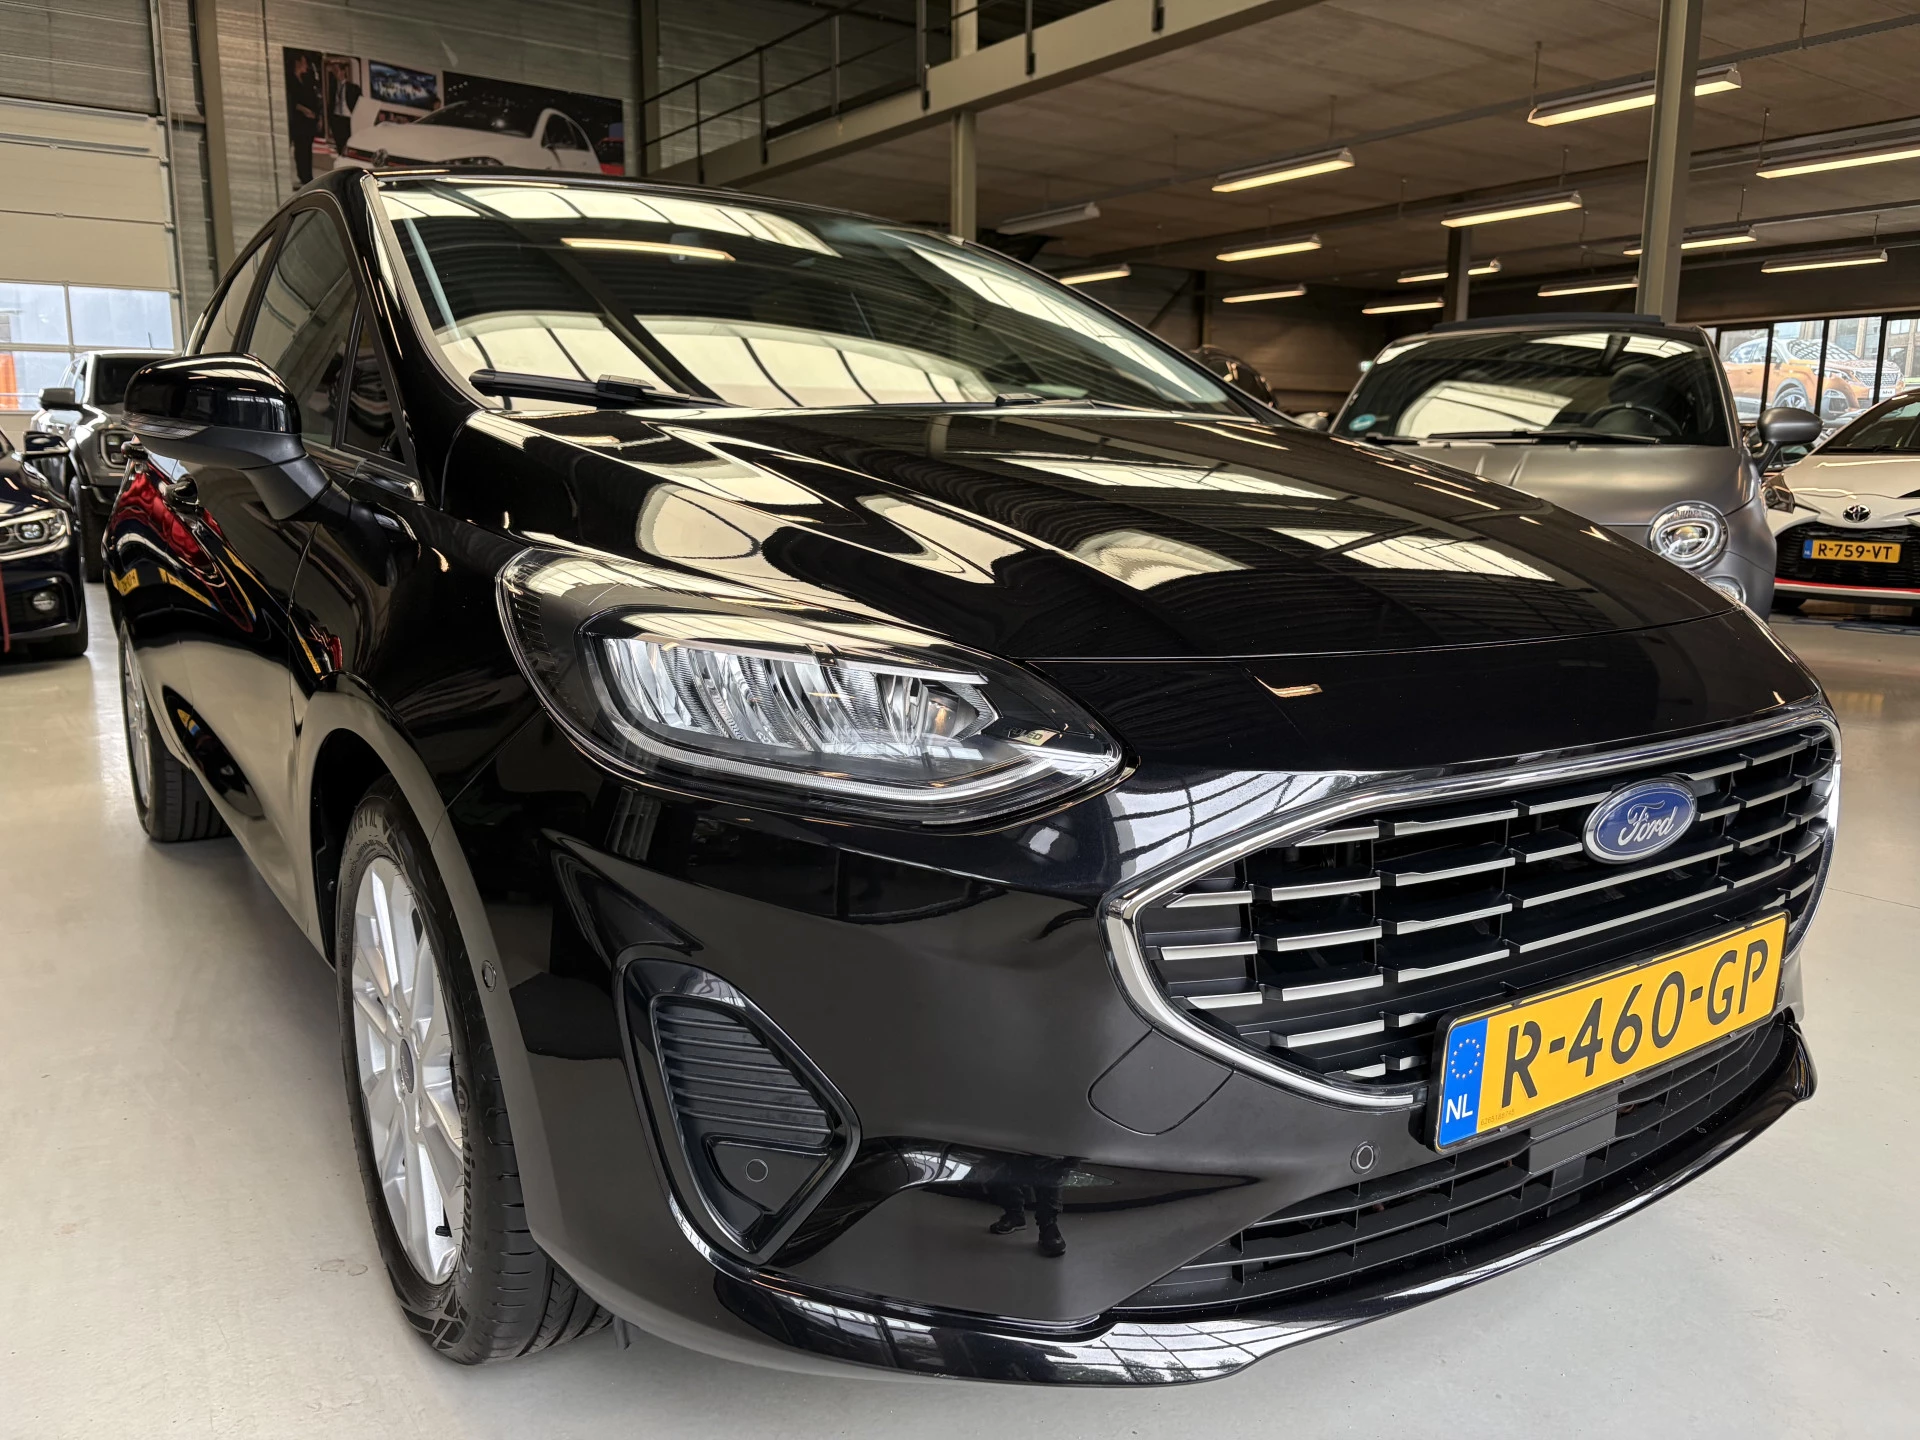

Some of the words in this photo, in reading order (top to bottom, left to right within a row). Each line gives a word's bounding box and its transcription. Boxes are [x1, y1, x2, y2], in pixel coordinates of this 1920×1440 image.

[1817, 543, 1893, 560] R-759-VT
[1617, 800, 1679, 846] Ford
[1501, 938, 1769, 1108] R-460-GP
[1445, 1093, 1474, 1124] NL
